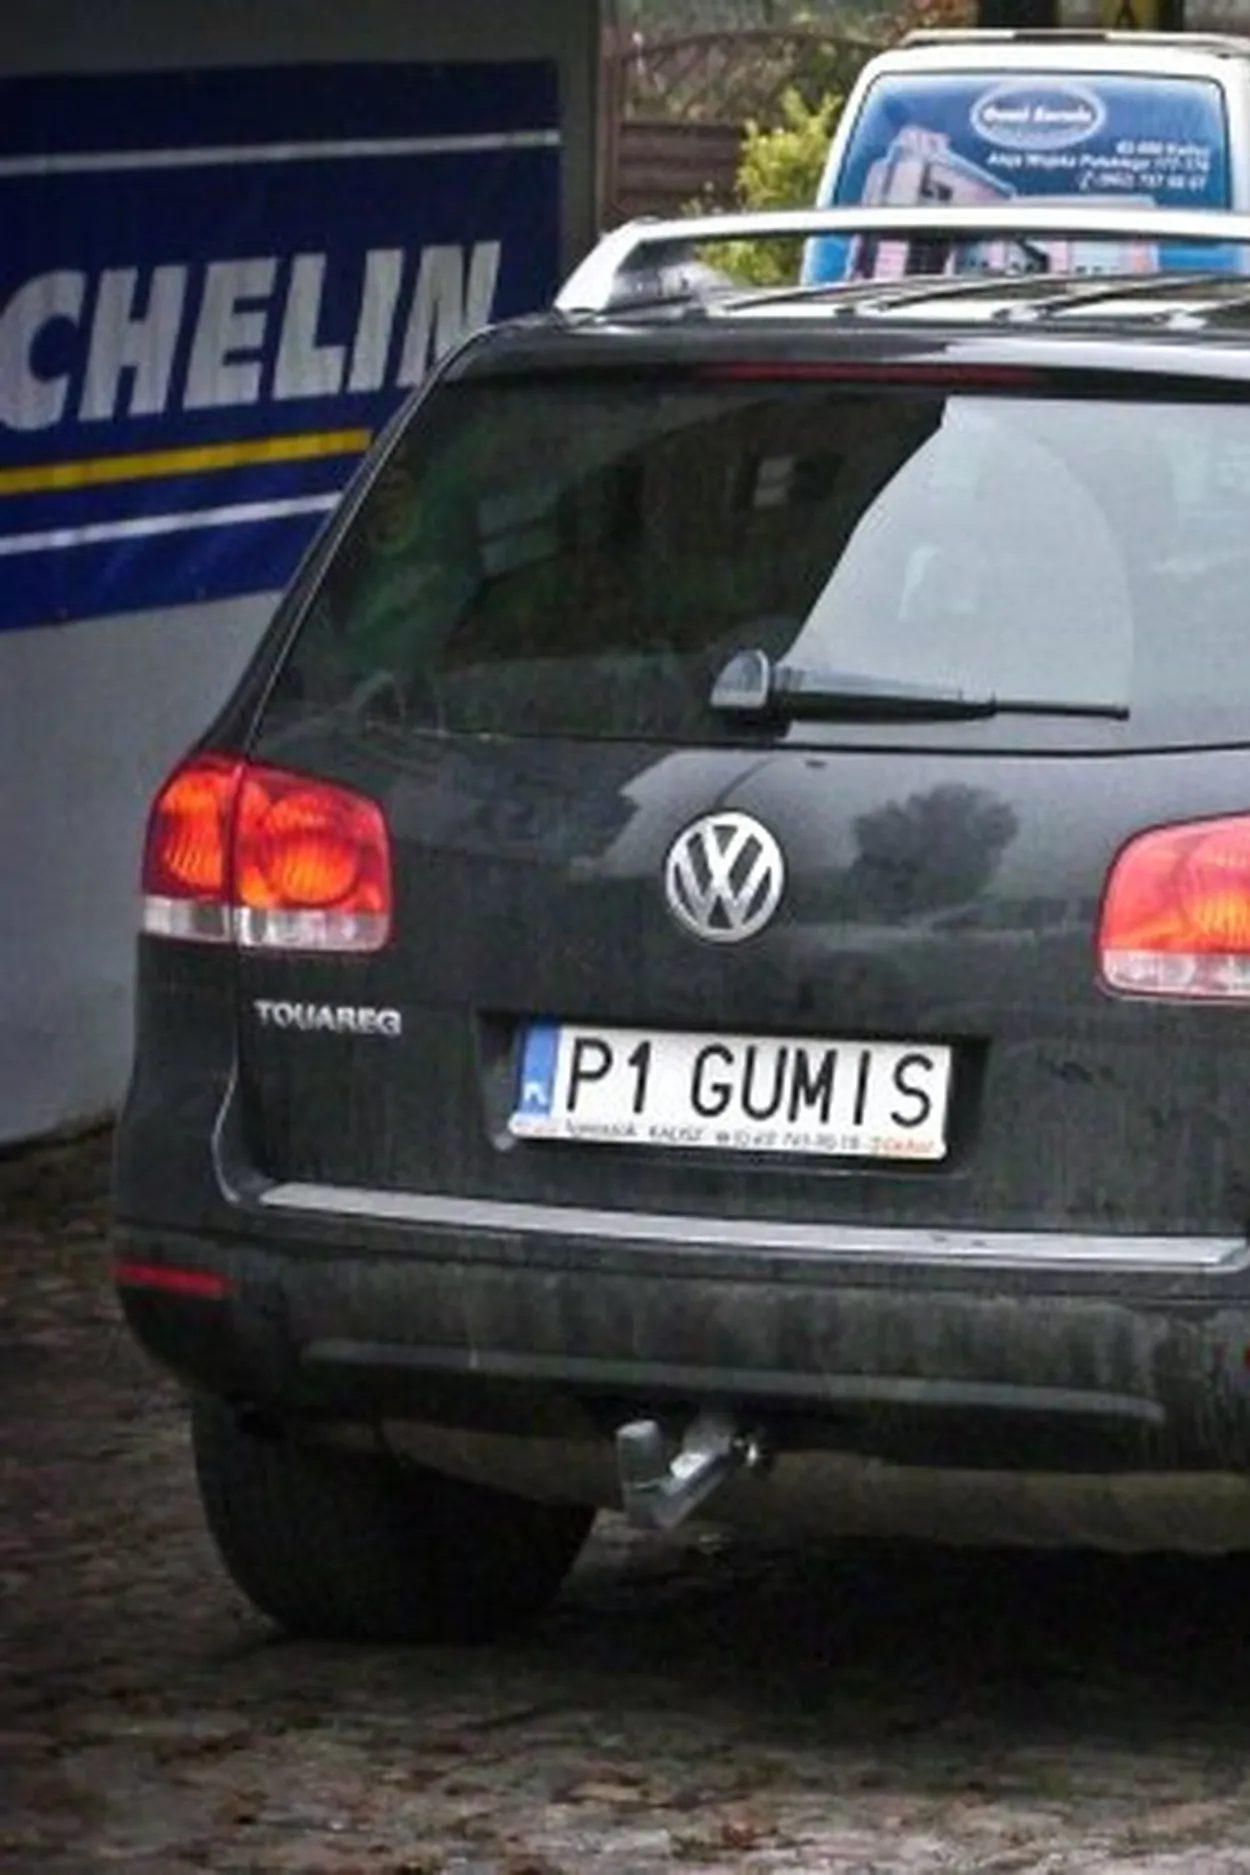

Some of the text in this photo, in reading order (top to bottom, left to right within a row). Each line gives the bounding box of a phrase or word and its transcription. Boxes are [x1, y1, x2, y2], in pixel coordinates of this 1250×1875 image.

[254, 999, 402, 1037] TOUAREG
[566, 1037, 934, 1128] P1 GUMIS
